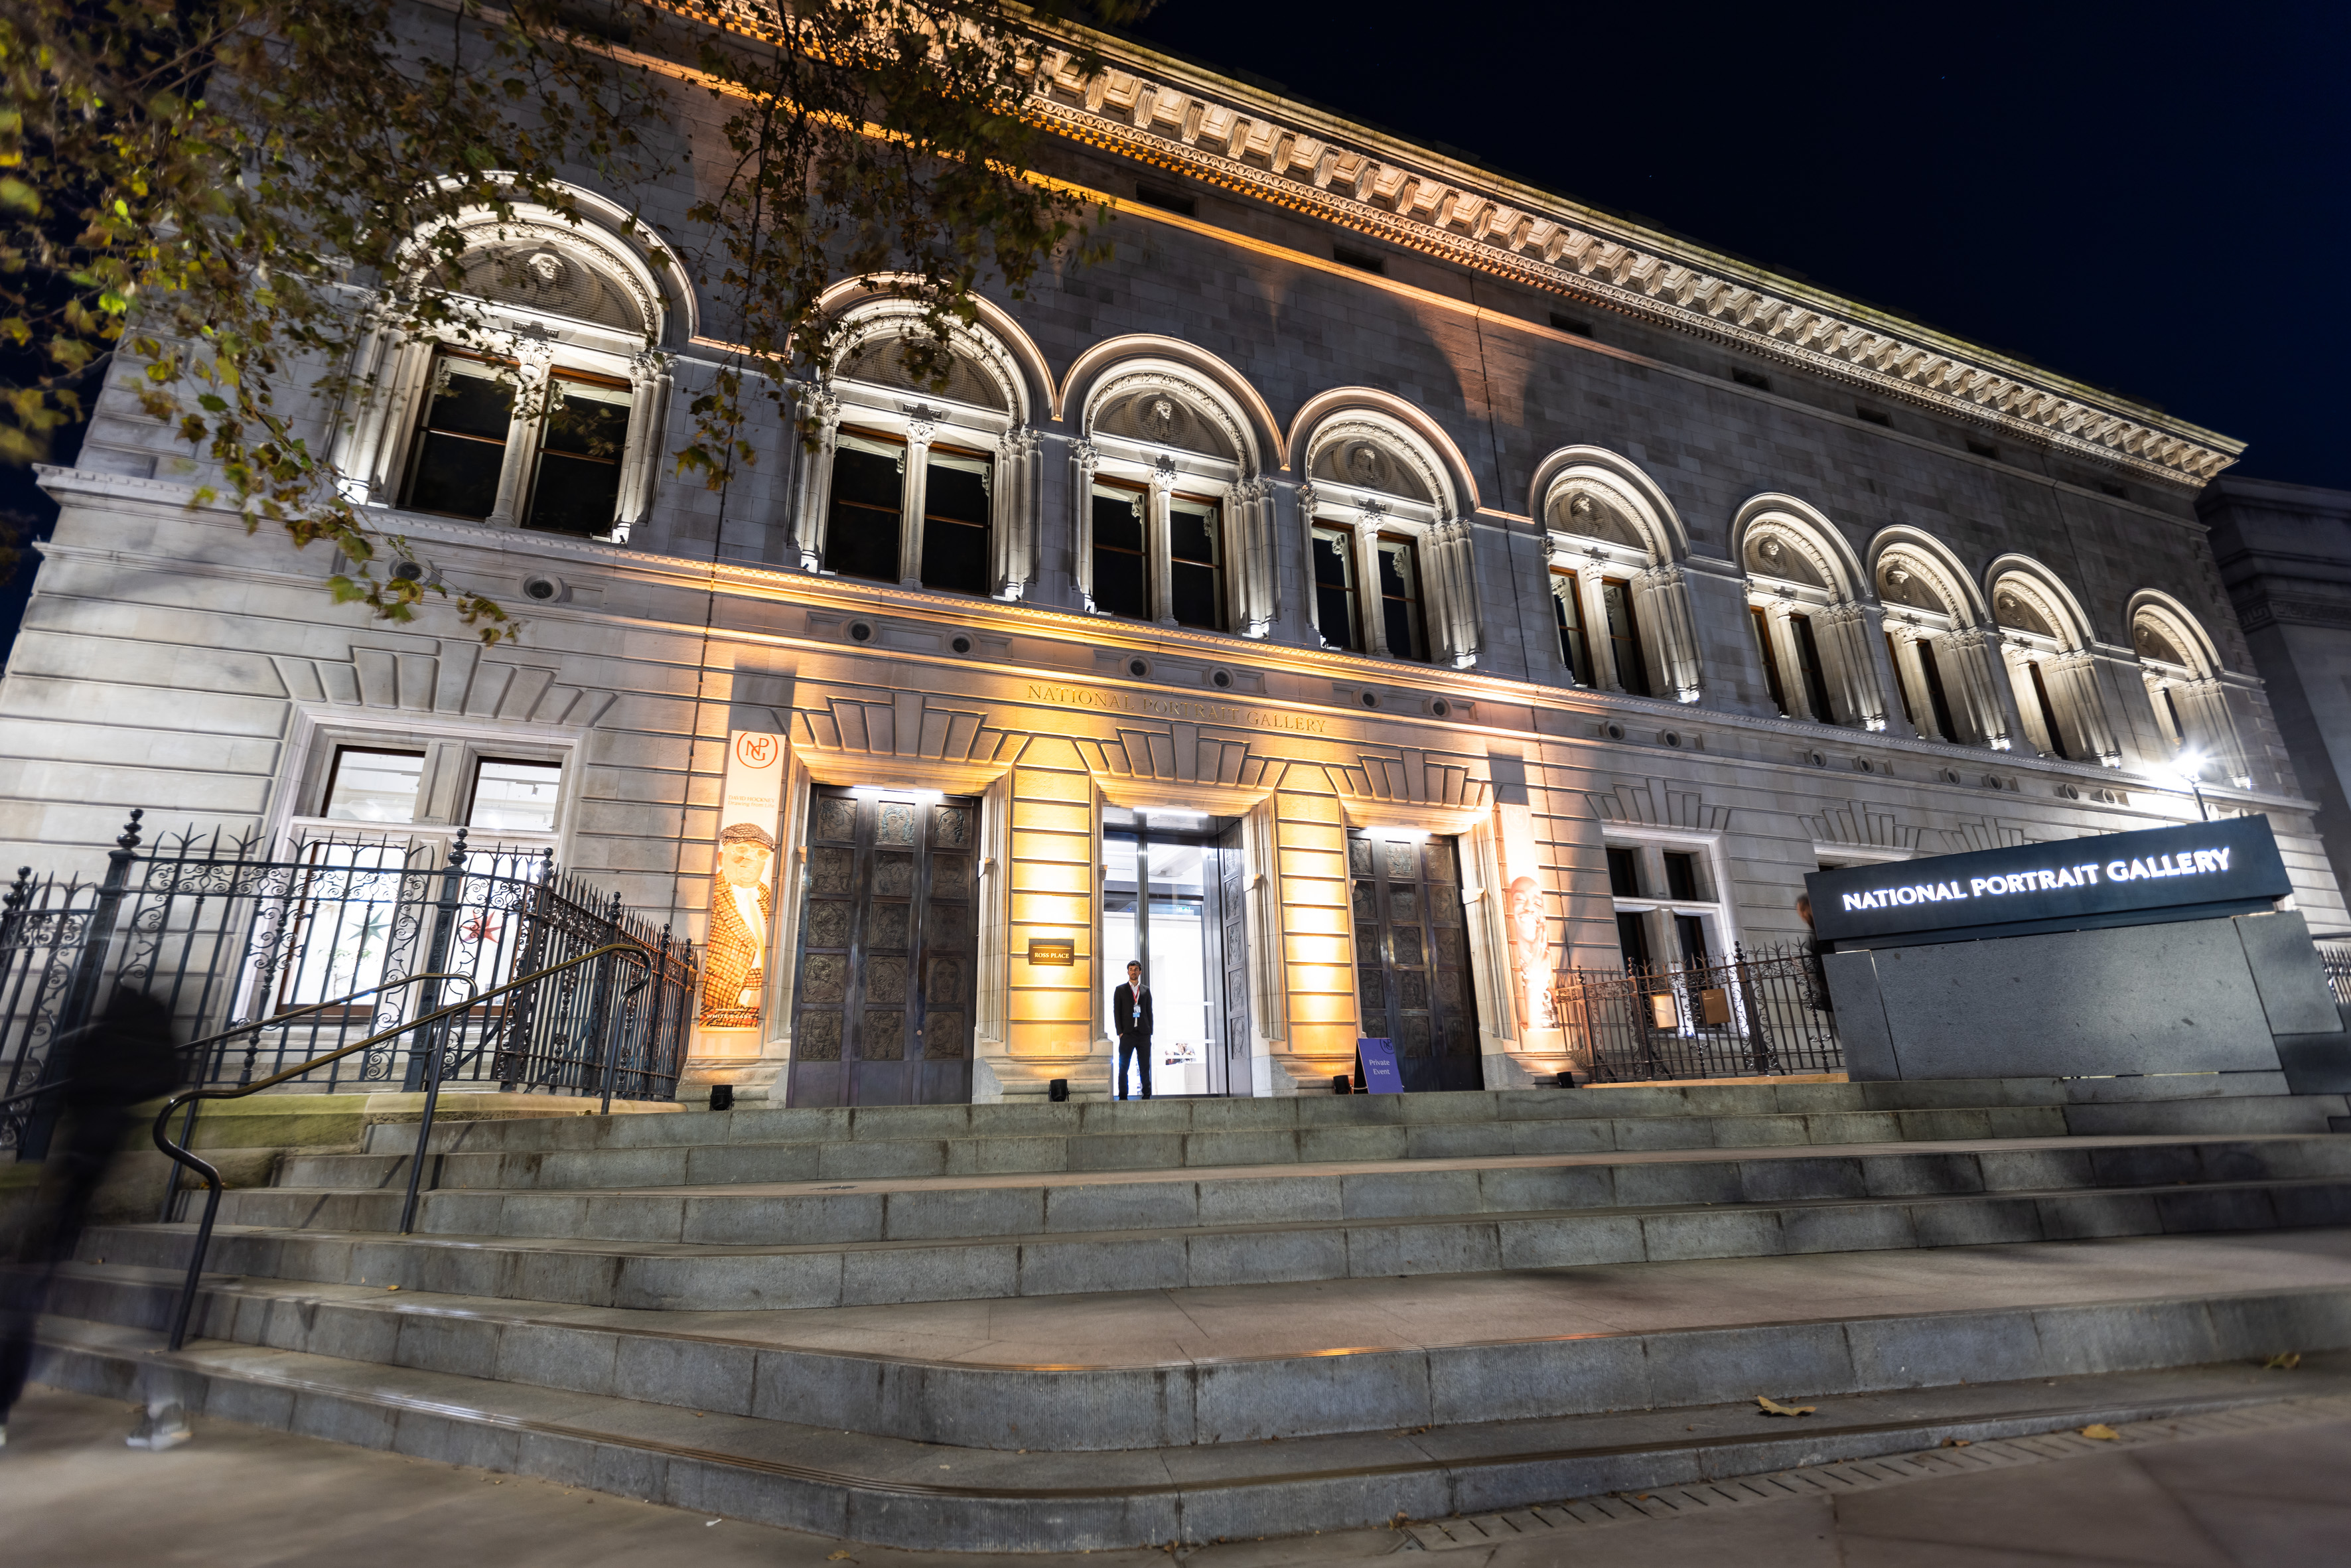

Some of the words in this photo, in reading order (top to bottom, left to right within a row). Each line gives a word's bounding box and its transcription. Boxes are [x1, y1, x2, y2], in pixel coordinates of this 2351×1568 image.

[1027, 683, 1135, 710] NATIONAL
[1142, 697, 1239, 722] PORTRAIT
[1247, 710, 1326, 733] GALLERY
[1841, 881, 1967, 911] NATIONAL
[1971, 865, 2099, 898] PORTRAIT
[2107, 847, 2231, 883] GALLERY
